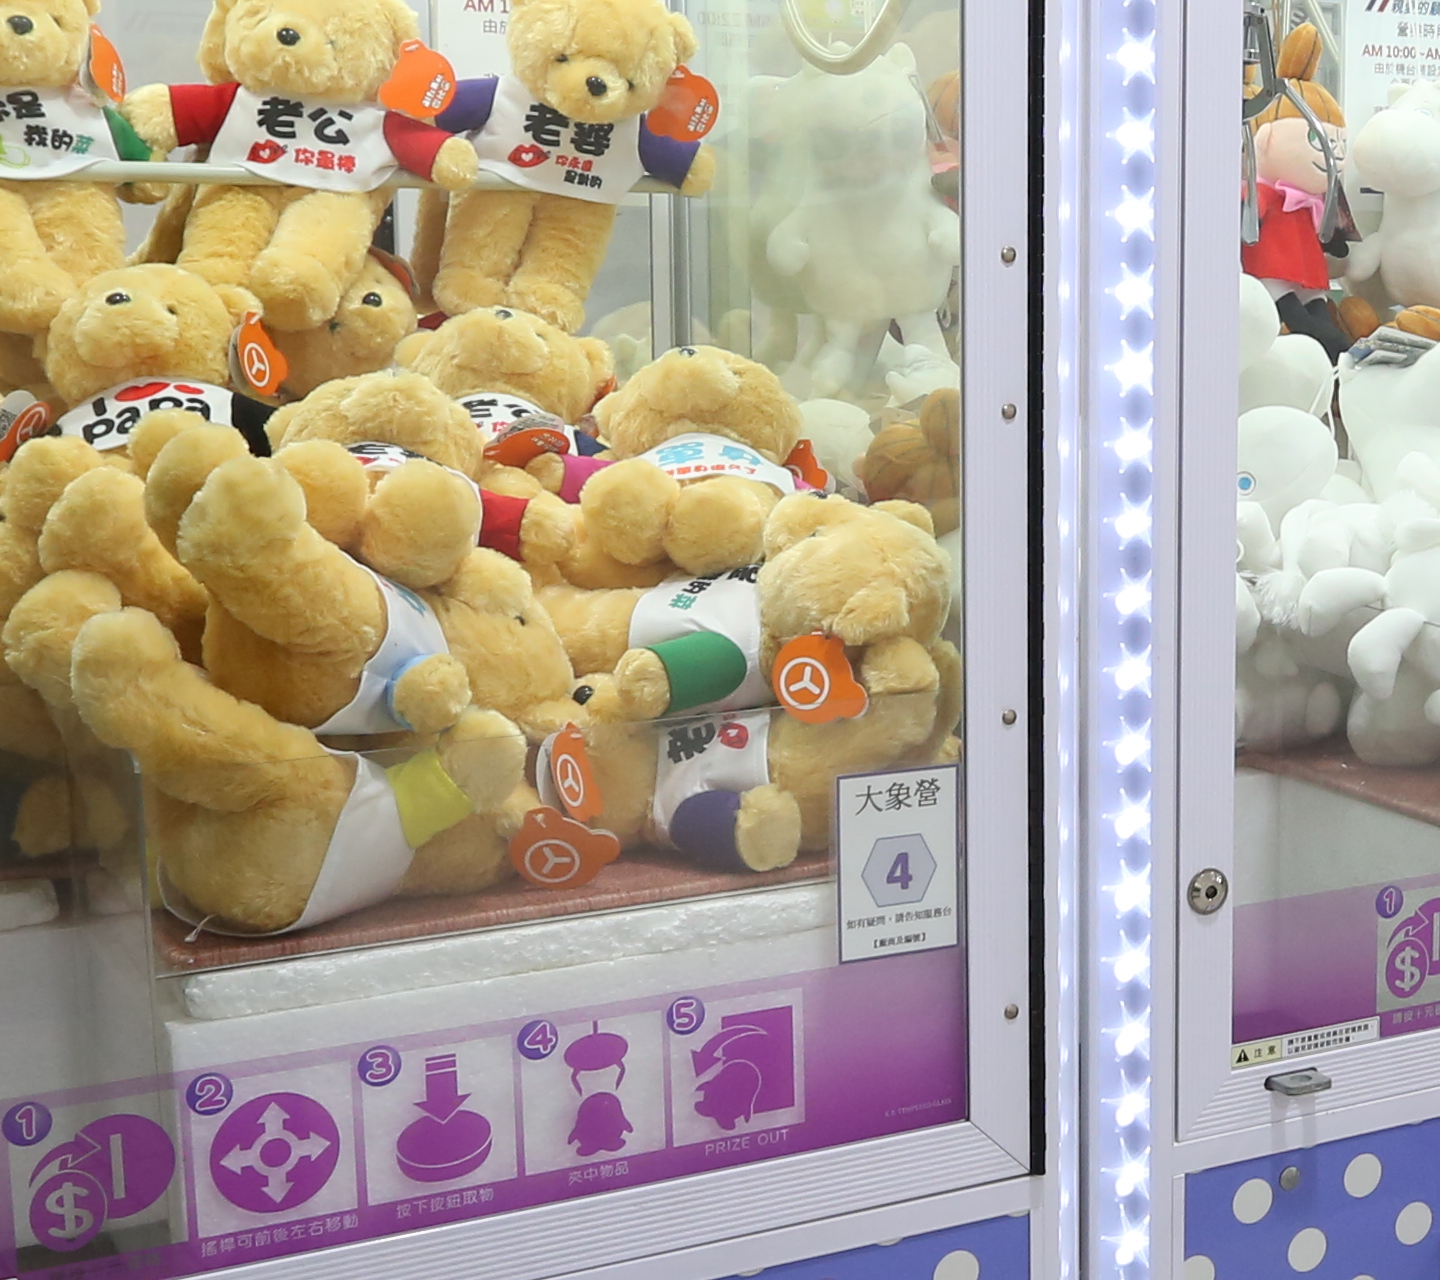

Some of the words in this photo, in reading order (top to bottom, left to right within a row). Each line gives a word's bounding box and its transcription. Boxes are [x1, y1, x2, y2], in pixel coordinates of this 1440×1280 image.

[256, 96, 354, 146] 老公
[523, 102, 615, 157] 老婆
[854, 777, 941, 817] 大象營
[885, 851, 913, 890] 4
[671, 999, 698, 1031] 5
[522, 1024, 556, 1056] 4
[365, 1050, 395, 1084] 3
[192, 1077, 228, 1112] 2
[15, 1104, 37, 1140] 1
[704, 1135, 752, 1156] PRIZE
[756, 1128, 789, 1148] OUT
[567, 1160, 630, 1186] 夾中物品
